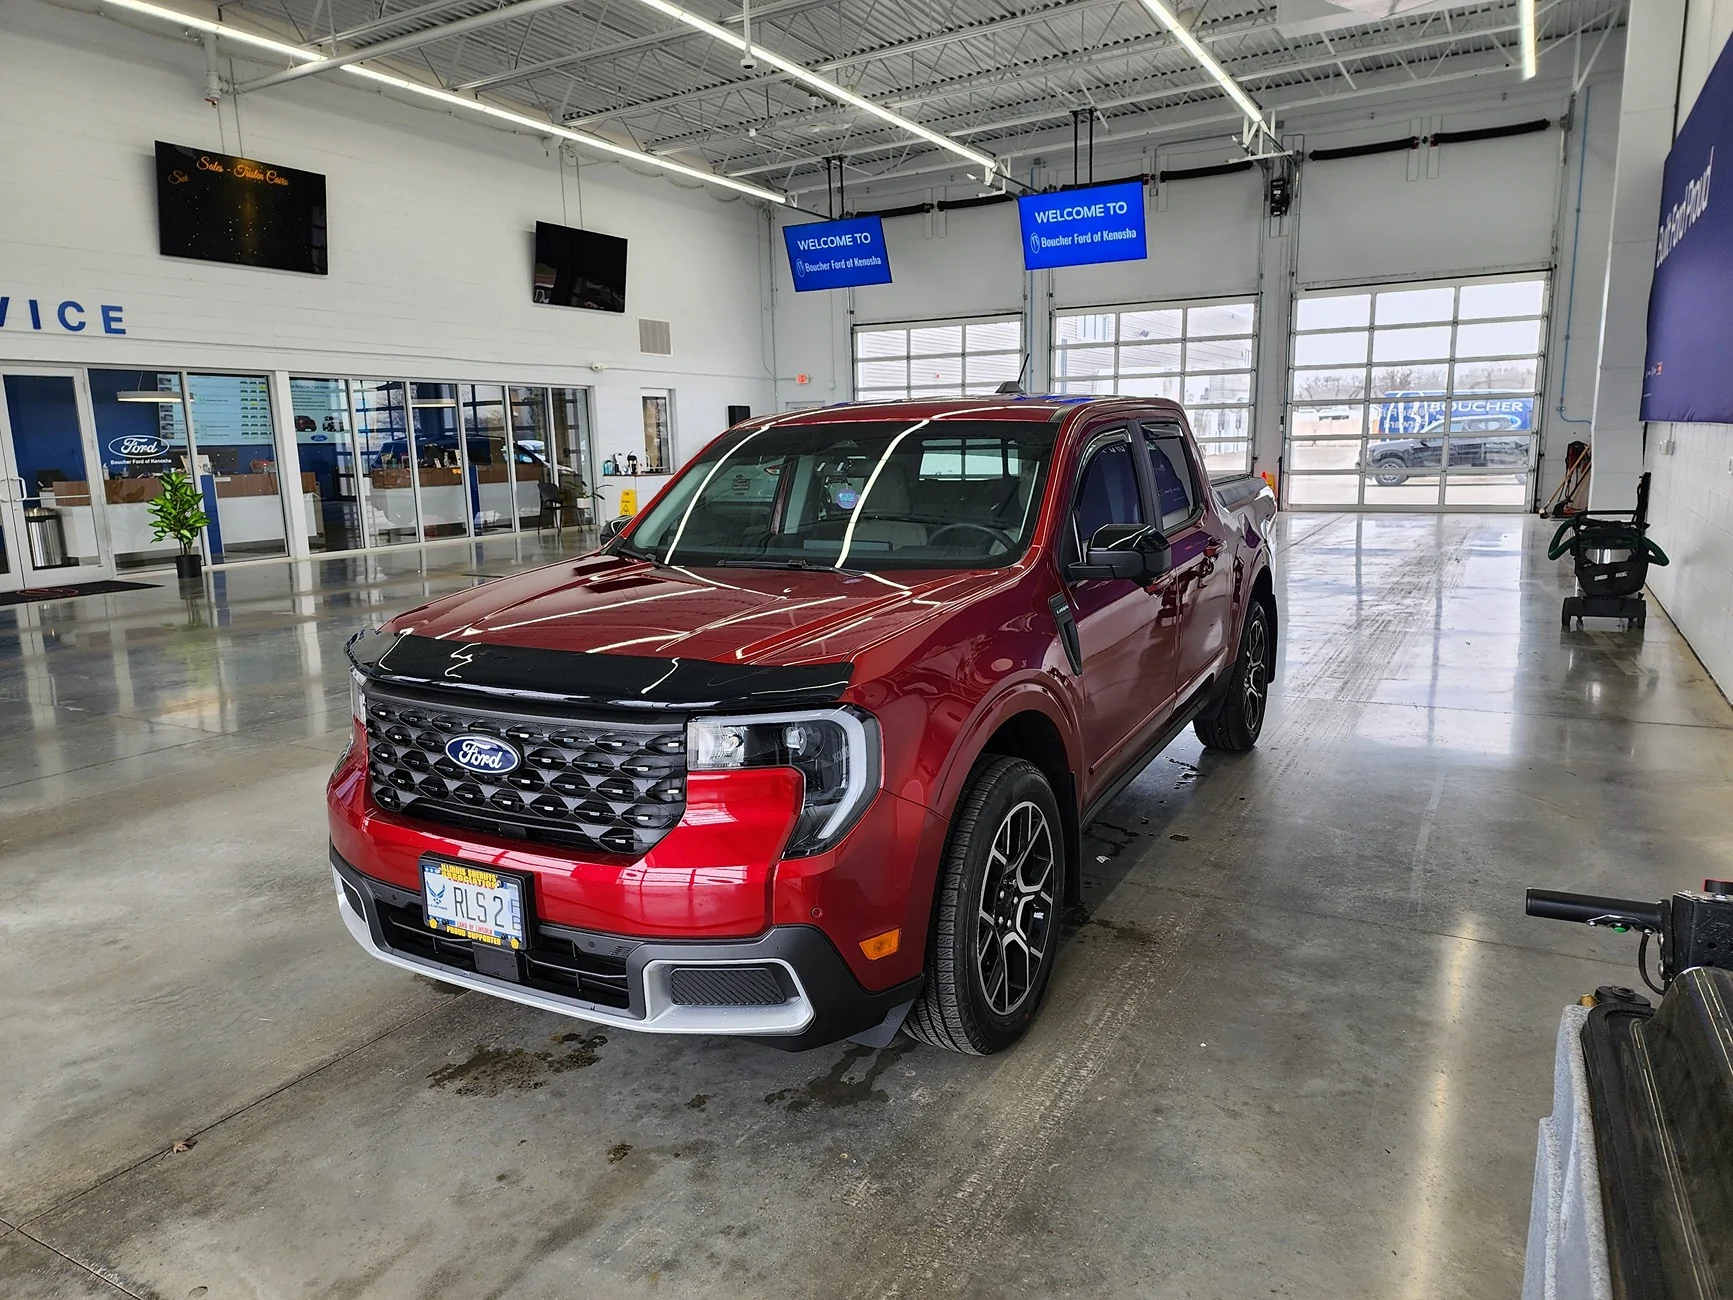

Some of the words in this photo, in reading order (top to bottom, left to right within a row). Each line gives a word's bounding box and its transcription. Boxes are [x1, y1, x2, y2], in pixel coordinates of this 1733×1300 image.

[196, 156, 224, 173] Sales
[1688, 146, 1714, 228] Proud
[1035, 204, 1105, 224] WELCOME
[1106, 201, 1128, 215] TO
[797, 234, 854, 251] WELCOME
[854, 232, 871, 244] TO
[1041, 235, 1072, 248] Boucher
[1073, 232, 1091, 244] Ford
[1093, 230, 1102, 242] of
[1103, 228, 1137, 241] Kenosha
[805, 260, 830, 273] Boucher
[831, 259, 845, 270] Ford
[846, 257, 854, 268] of
[854, 256, 882, 268] Kenosha
[1430, 401, 1523, 412] BOUCHER
[121, 437, 158, 454] Ford
[459, 740, 503, 769] Ford
[441, 863, 467, 877] ILLINOIS
[441, 871, 497, 890] ASSOCIATION
[446, 925, 466, 937] PROUD
[467, 931, 502, 946] SUPPORTER
[457, 921, 468, 930] LAND
[475, 925, 493, 935] LINCOLN
